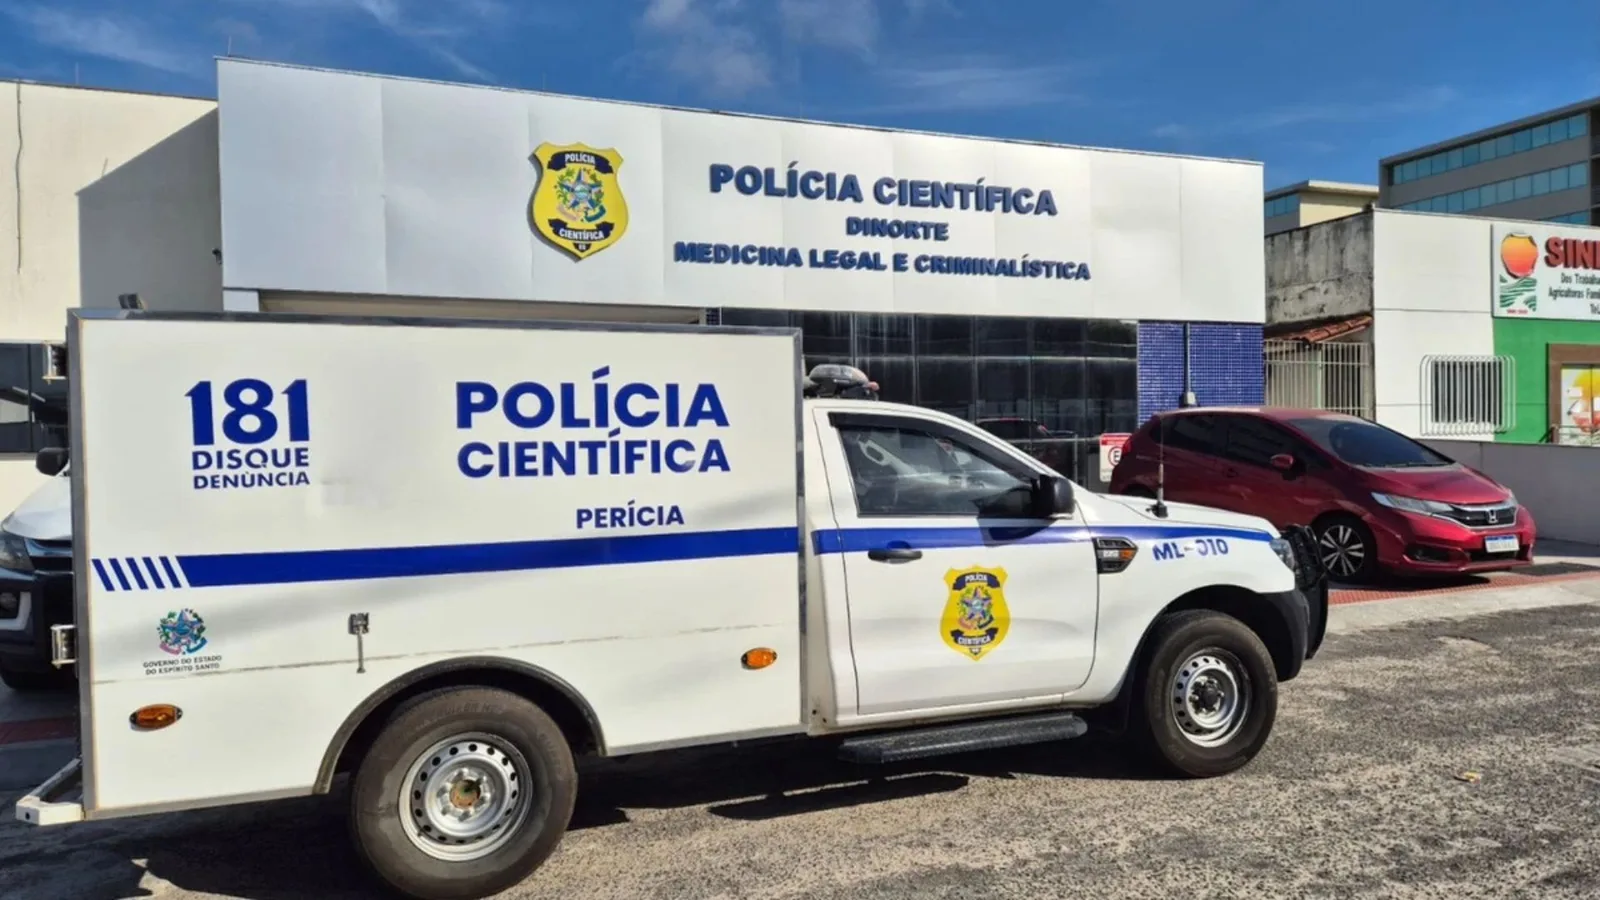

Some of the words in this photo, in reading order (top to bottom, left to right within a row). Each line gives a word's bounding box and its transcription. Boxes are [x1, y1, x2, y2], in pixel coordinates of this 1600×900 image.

[565, 153, 596, 164] POLÍCIA
[709, 161, 863, 203] POLÍCIA
[873, 177, 1058, 216] CIENTÍFICA
[846, 216, 949, 241] DINORTE
[674, 241, 803, 267] MEDICINA
[809, 248, 887, 271] LEGAL
[893, 253, 909, 272] E
[914, 253, 1091, 280] CRIMINALÍSTICA
[456, 365, 730, 429] POLÍCIA
[184, 378, 310, 446] 181
[192, 447, 309, 470] DISQUE
[457, 427, 731, 478] CIENTÍFICA
[576, 500, 685, 529] PERÍCIA
[143, 659, 179, 668] GOVERNO
[194, 655, 222, 663] ESTADO
[195, 662, 220, 670] SANTO
